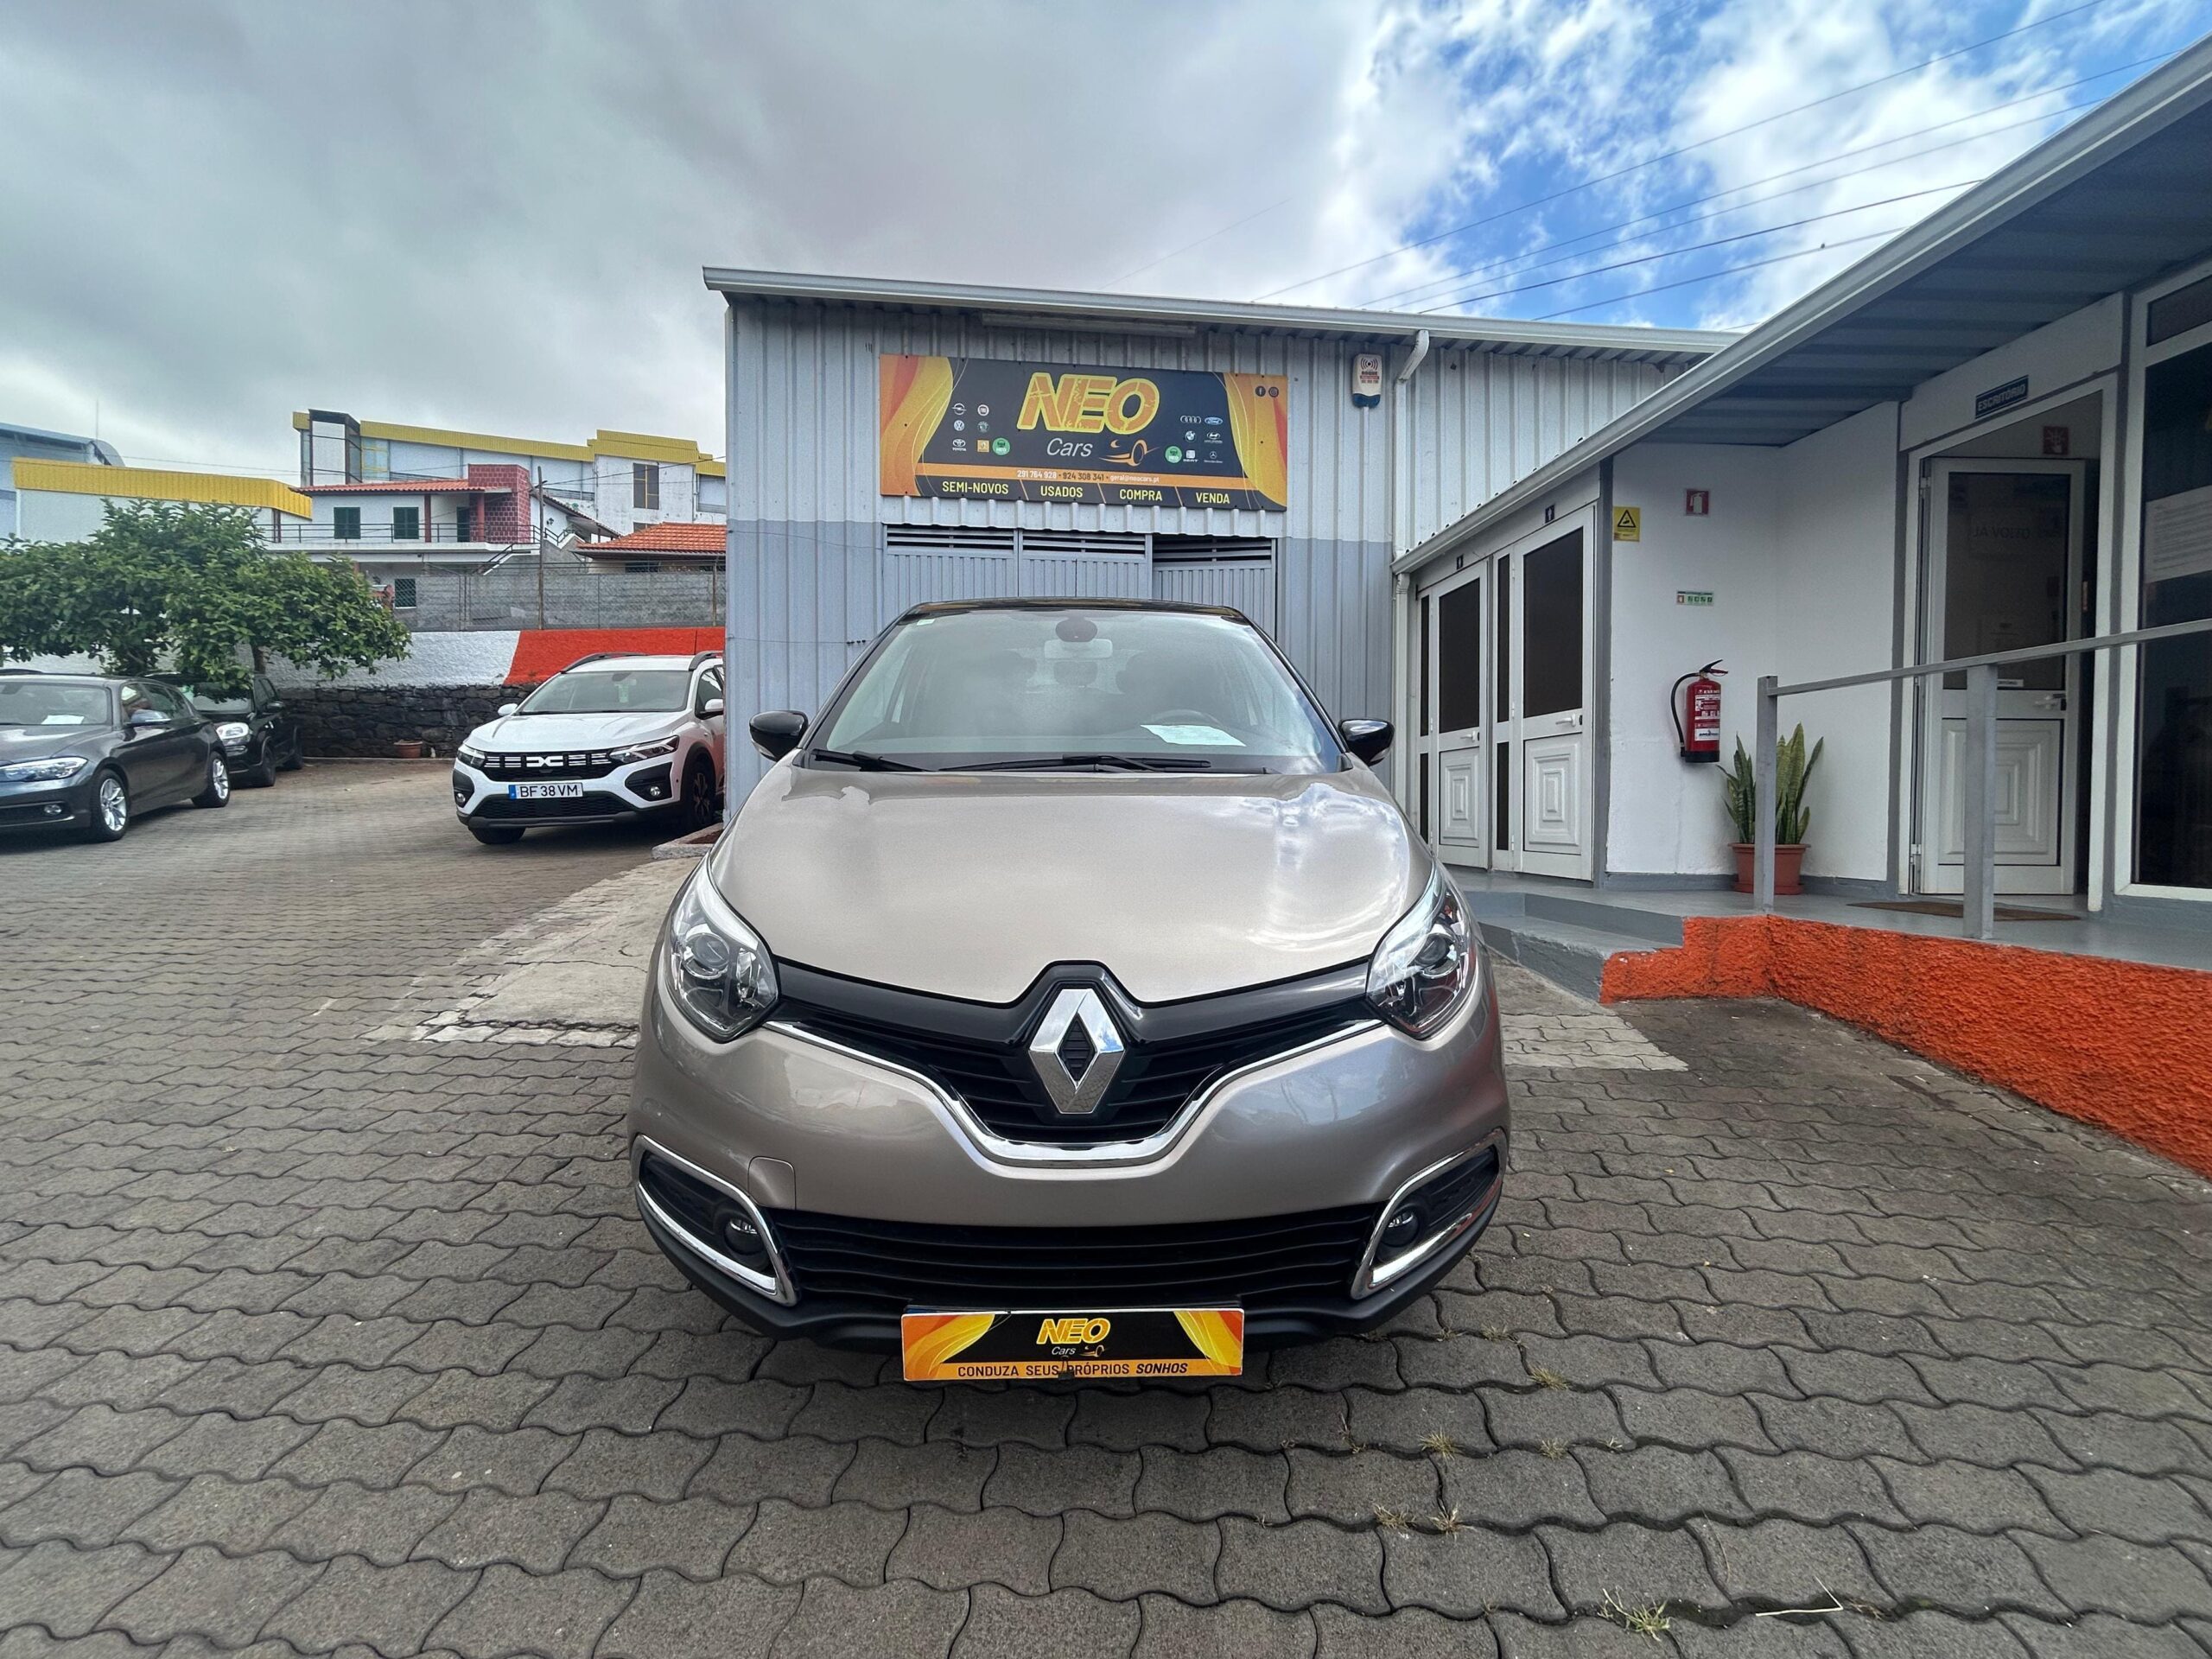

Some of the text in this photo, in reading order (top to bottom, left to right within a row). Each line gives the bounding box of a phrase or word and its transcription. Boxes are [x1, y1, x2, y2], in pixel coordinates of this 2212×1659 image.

[1016, 372, 1160, 435] NEO
[1046, 437, 1093, 457] Cars
[1063, 471, 1076, 480] 924
[1092, 472, 1104, 480] 341
[942, 480, 1230, 504] SEMI-NOVOS USADOS COMPRA VENDA
[519, 785, 578, 798] BF 38 VM
[1036, 1318, 1111, 1344] NEO
[1051, 1346, 1077, 1355] Cars
[957, 1365, 1019, 1376] CONDUZA
[1026, 1364, 1059, 1376] SEUS
[1136, 1363, 1189, 1374] SONHOS
